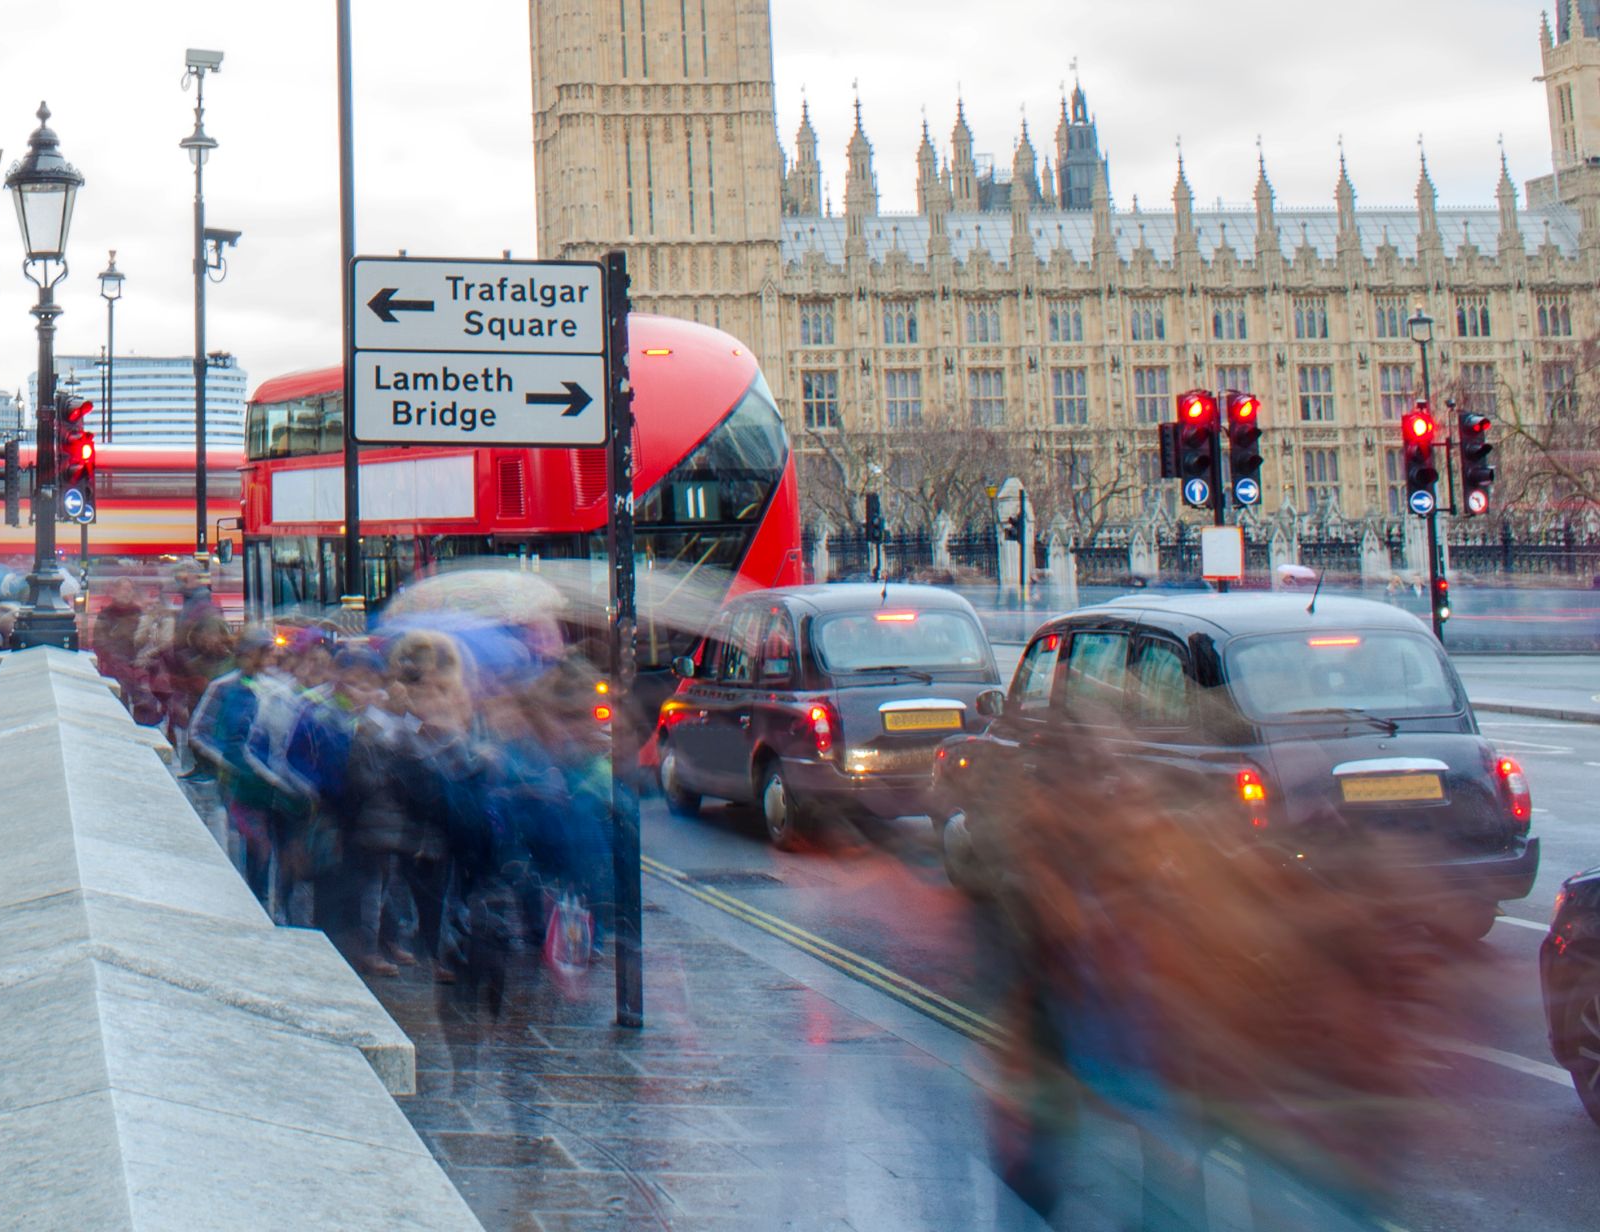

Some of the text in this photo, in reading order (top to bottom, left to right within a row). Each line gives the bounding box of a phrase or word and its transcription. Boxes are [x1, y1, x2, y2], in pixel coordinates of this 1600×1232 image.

[445, 276, 589, 307] Trafalgar
[463, 310, 578, 340] Square
[374, 365, 513, 392] Lambeth
[392, 401, 497, 431] Bridge
[686, 487, 706, 519] 11
